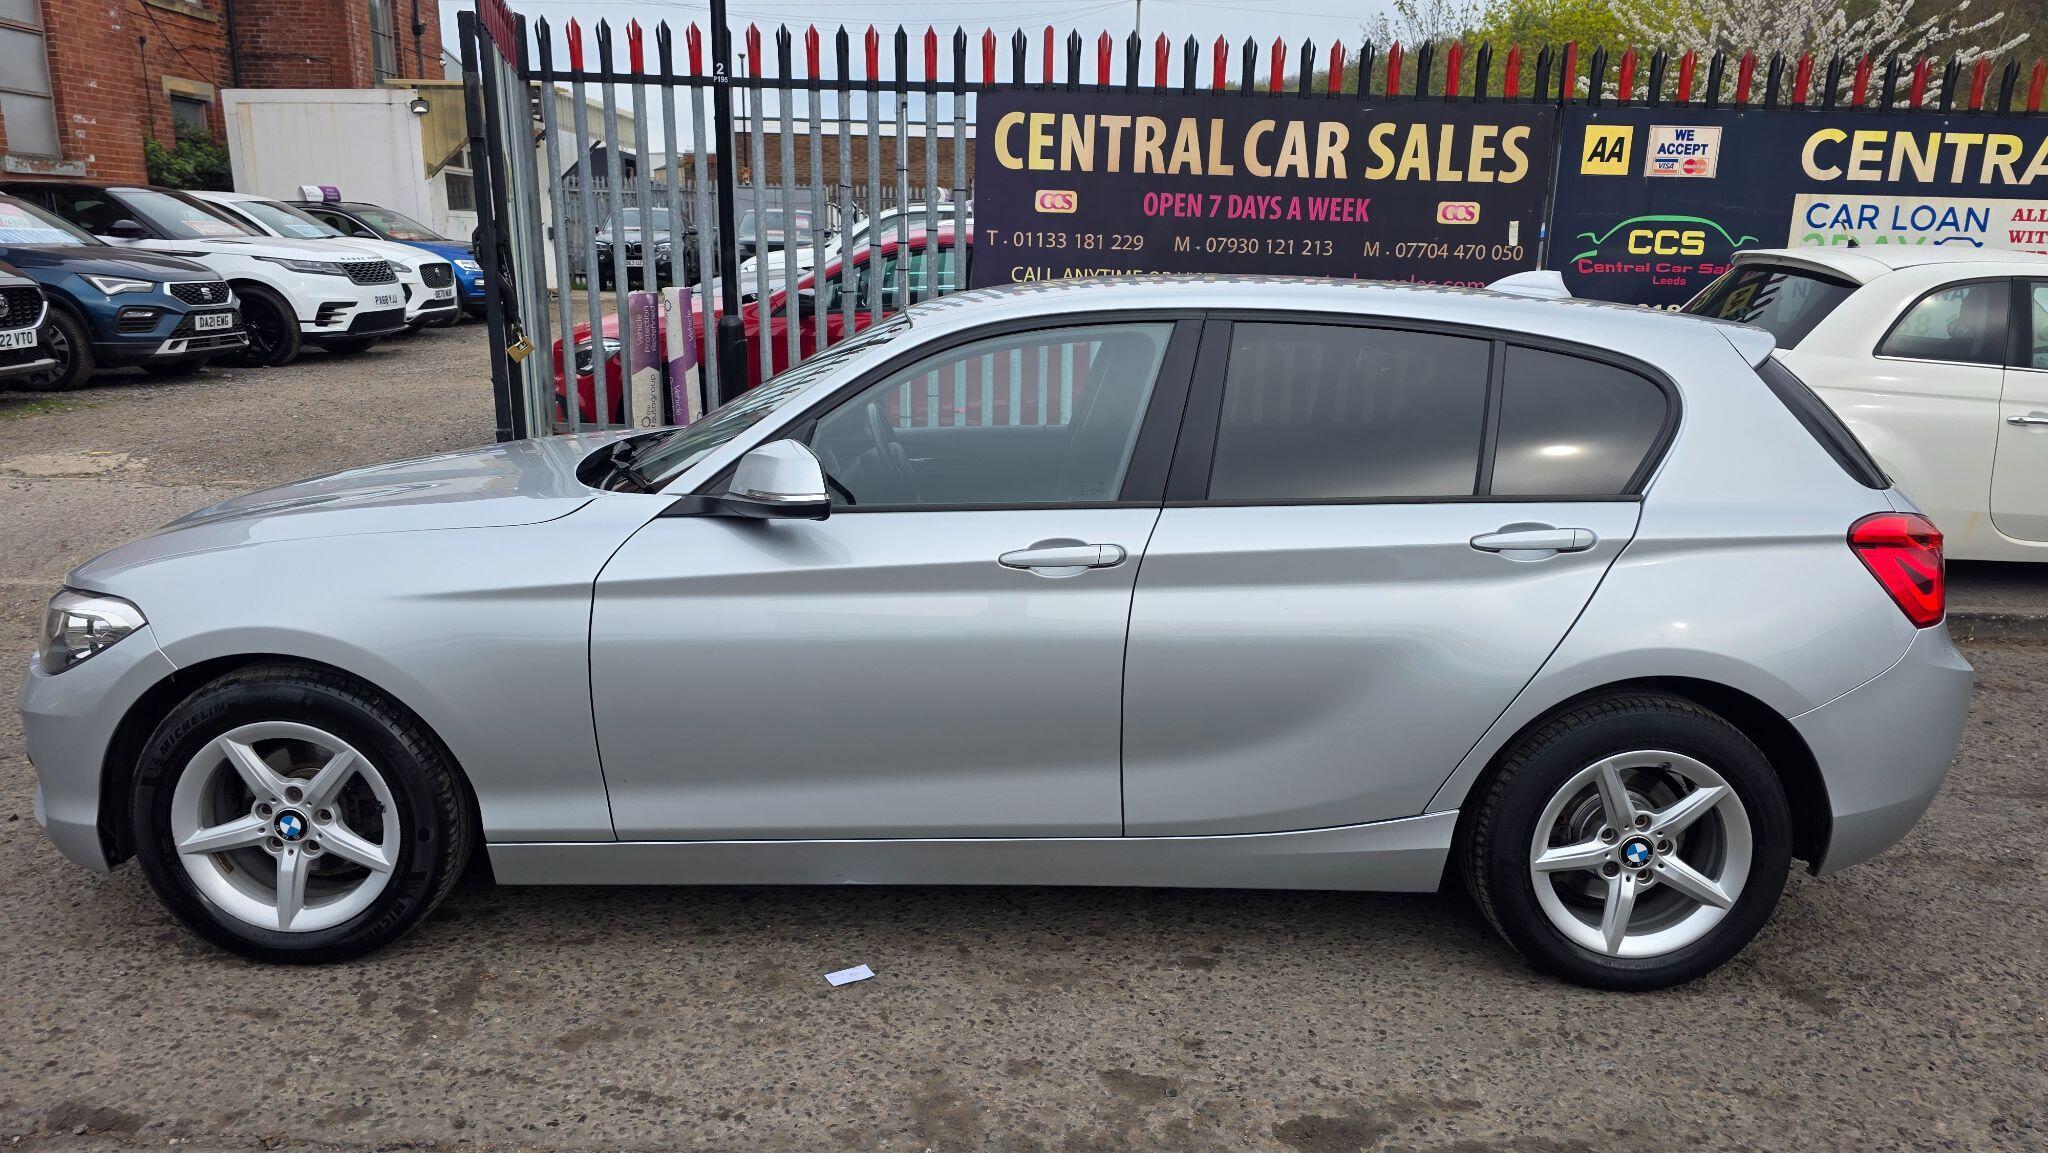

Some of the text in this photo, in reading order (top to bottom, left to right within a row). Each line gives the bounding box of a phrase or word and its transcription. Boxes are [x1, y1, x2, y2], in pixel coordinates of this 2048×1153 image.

[716, 62, 725, 75] 2
[1675, 129, 1695, 142] WE
[994, 111, 1531, 184] CENTRAL CAR SALES
[1587, 136, 1625, 163] AA
[1657, 143, 1708, 156] ACCEPT
[1658, 162, 1675, 170] VISA
[1144, 191, 1371, 222] OPEN 7 DAYS A WEEK
[1805, 202, 1991, 233] CAR LOAN
[1013, 231, 1067, 249] 01133
[1075, 233, 1104, 250] 181
[1111, 234, 1144, 251] 229
[1206, 237, 1259, 254] 07930
[1266, 239, 1294, 255] 121
[1302, 240, 1333, 256] 213
[1628, 229, 1706, 256] CCS
[1395, 242, 1449, 259] 07704
[1454, 244, 1486, 261] 470
[1491, 245, 1524, 261] 050
[1577, 258, 1650, 274] Central
[1655, 263, 1693, 273] Car
[1652, 276, 1687, 286] Leeds
[14, 331, 33, 346] VTO
